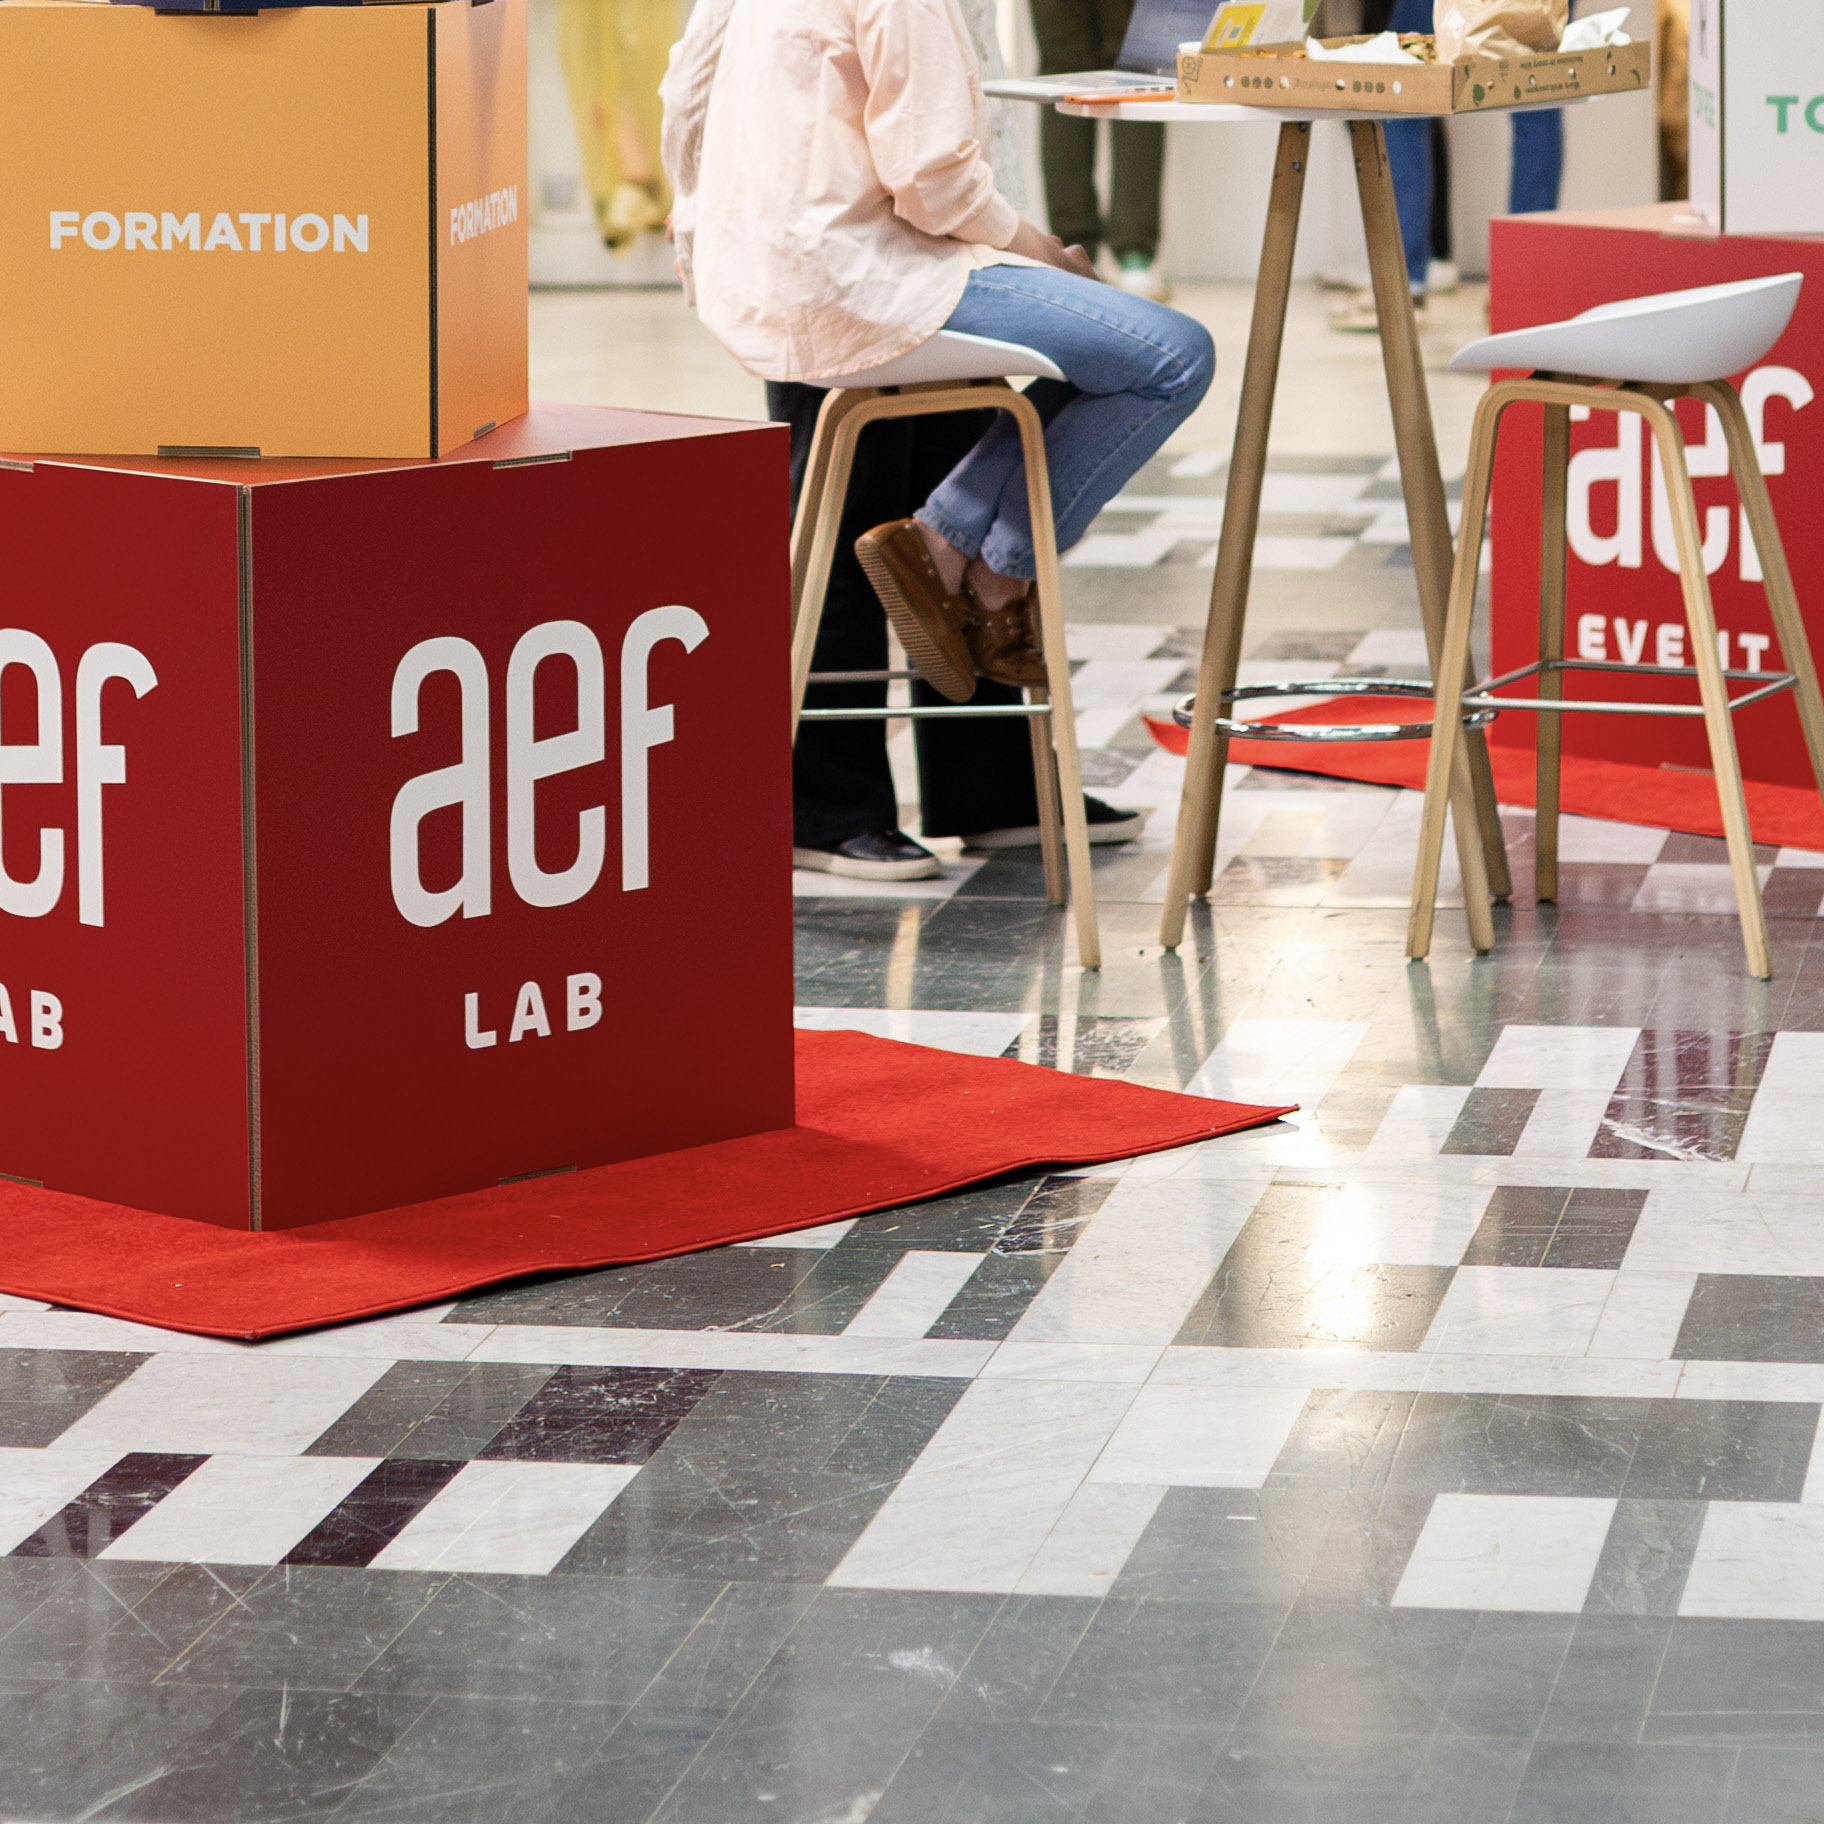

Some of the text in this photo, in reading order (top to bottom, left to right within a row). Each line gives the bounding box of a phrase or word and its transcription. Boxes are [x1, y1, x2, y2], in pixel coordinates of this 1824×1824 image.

[49, 210, 369, 253] FORMATION
[450, 184, 518, 246] FORMATION
[389, 605, 710, 928] aef
[464, 972, 603, 1050] LAB
